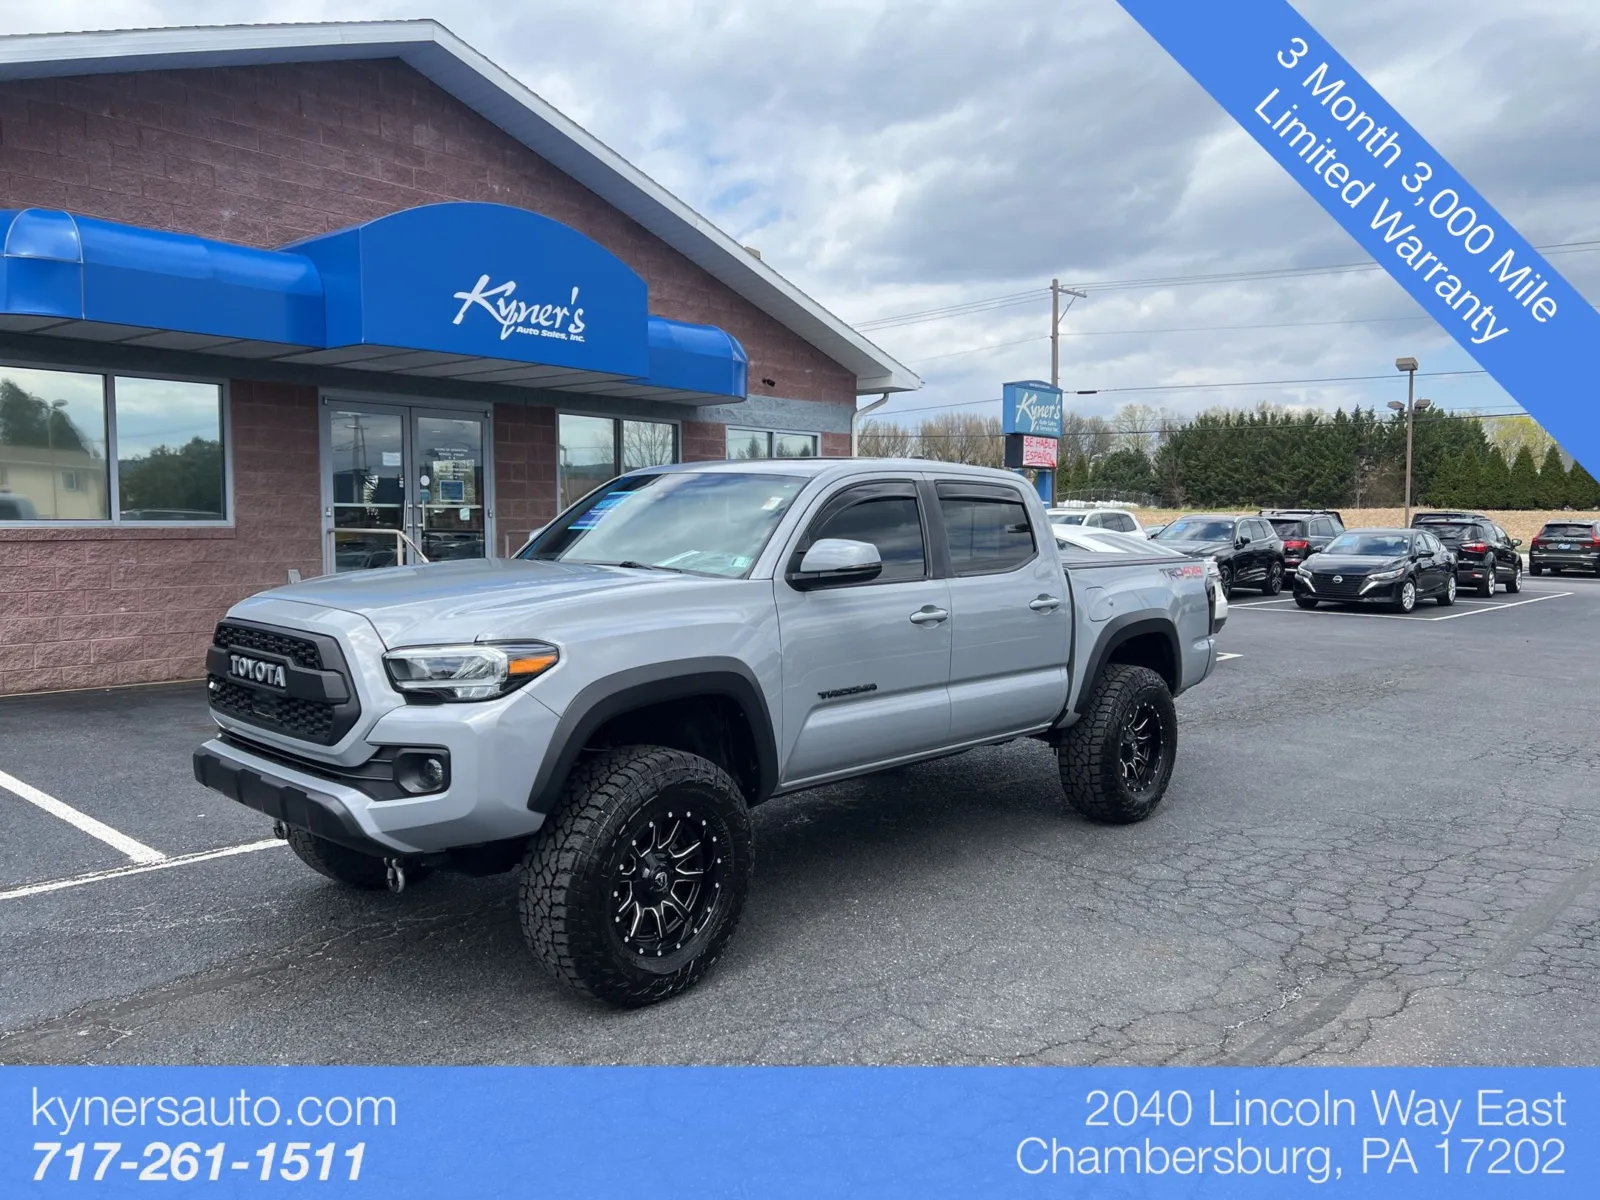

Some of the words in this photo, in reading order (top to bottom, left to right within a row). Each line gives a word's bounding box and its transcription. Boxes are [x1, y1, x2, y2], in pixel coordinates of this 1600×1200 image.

[452, 273, 586, 341] Kyner's
[516, 326, 540, 336] Auto
[541, 329, 568, 341] Sales,
[569, 333, 586, 342] Inc.
[1015, 391, 1060, 432] Kyner's
[1024, 437, 1034, 448] SE
[230, 654, 286, 687] TOYOTA
